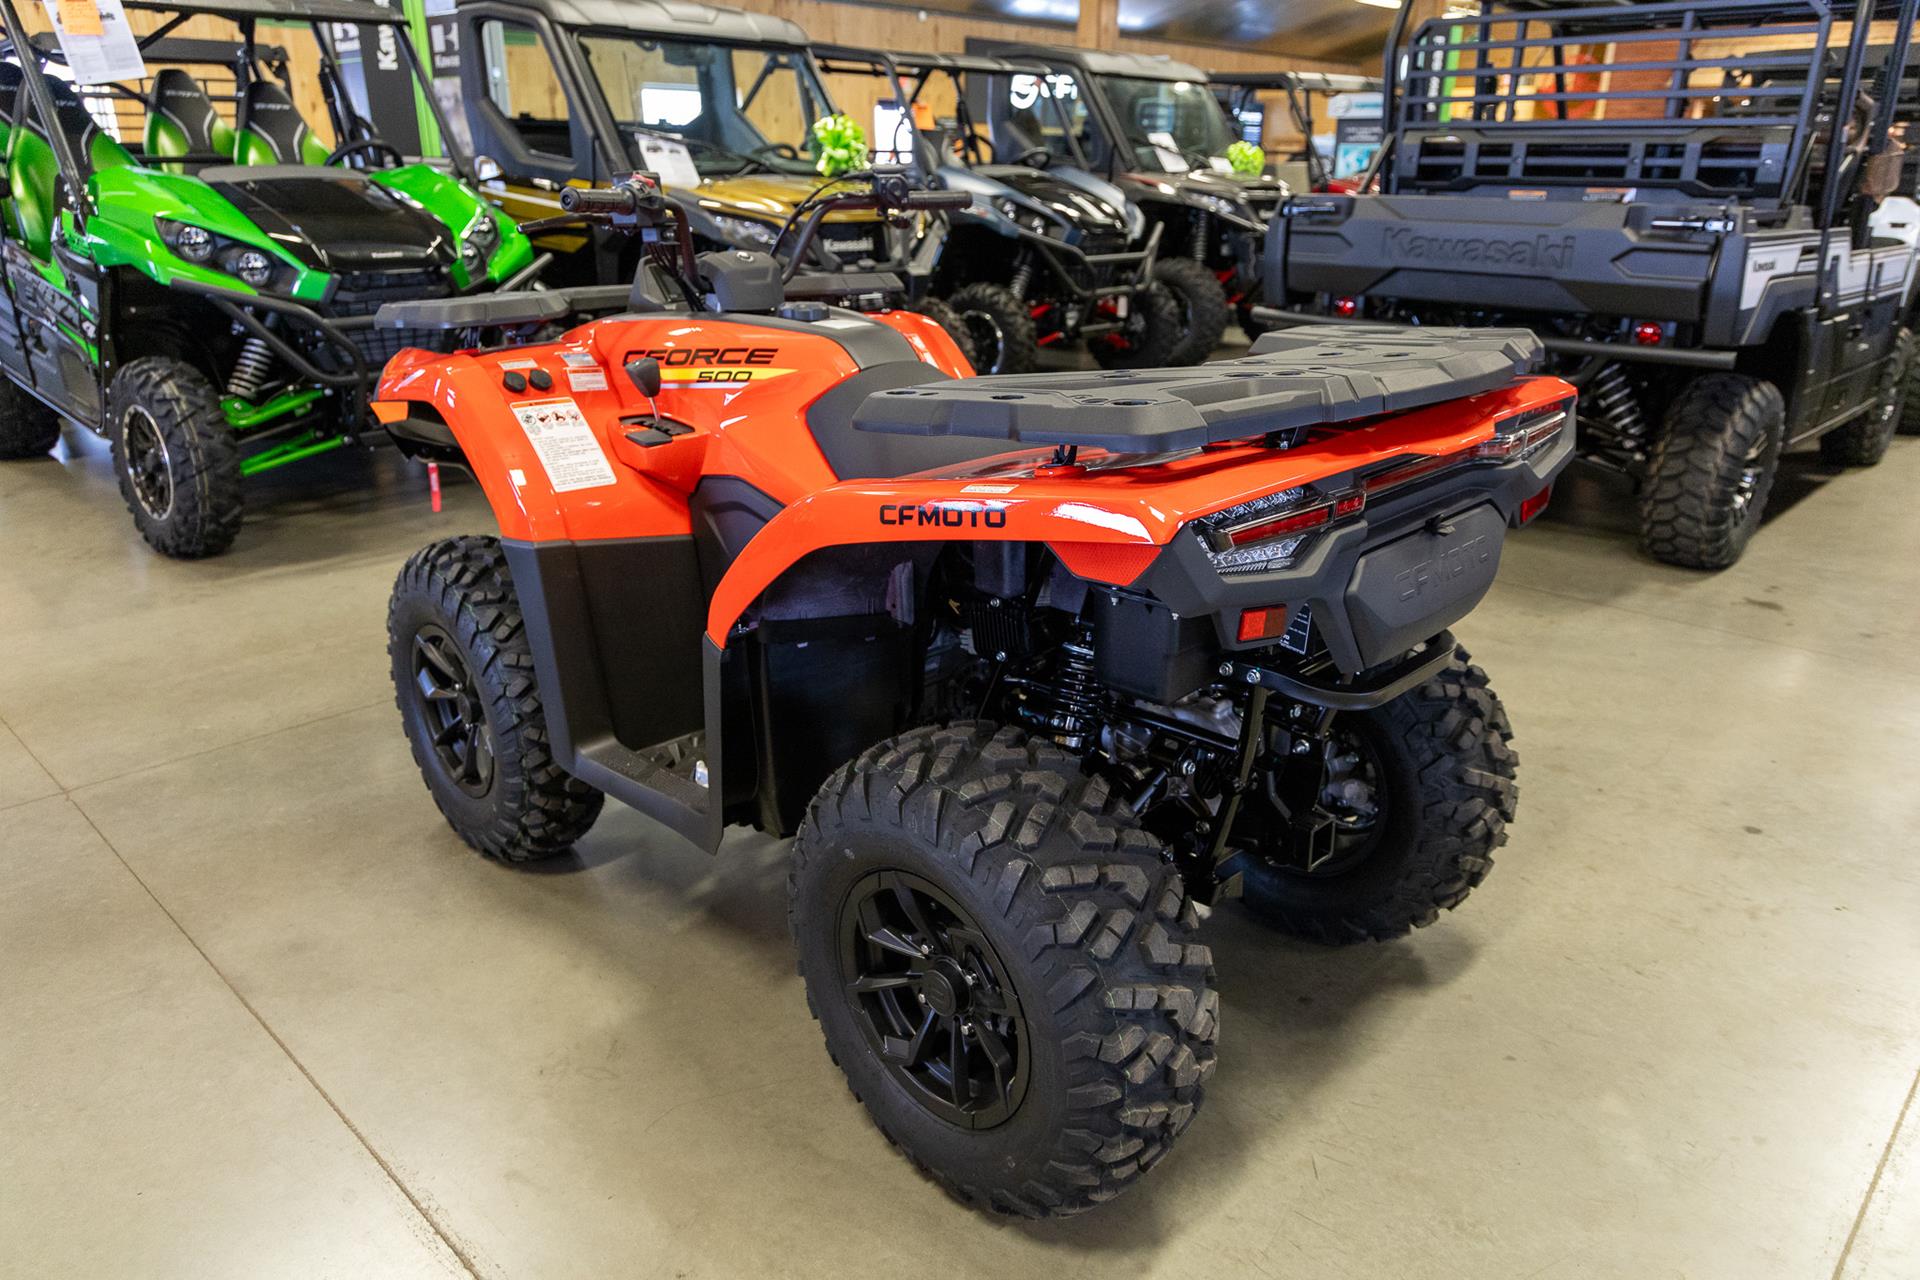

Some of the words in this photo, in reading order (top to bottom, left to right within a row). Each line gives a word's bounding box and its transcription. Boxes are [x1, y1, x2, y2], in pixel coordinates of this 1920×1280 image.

[1382, 226, 1577, 270] Kawasaki
[696, 370, 753, 383] 500
[880, 504, 1006, 529] CFMOTO
[1393, 535, 1489, 602] CFMOTO
